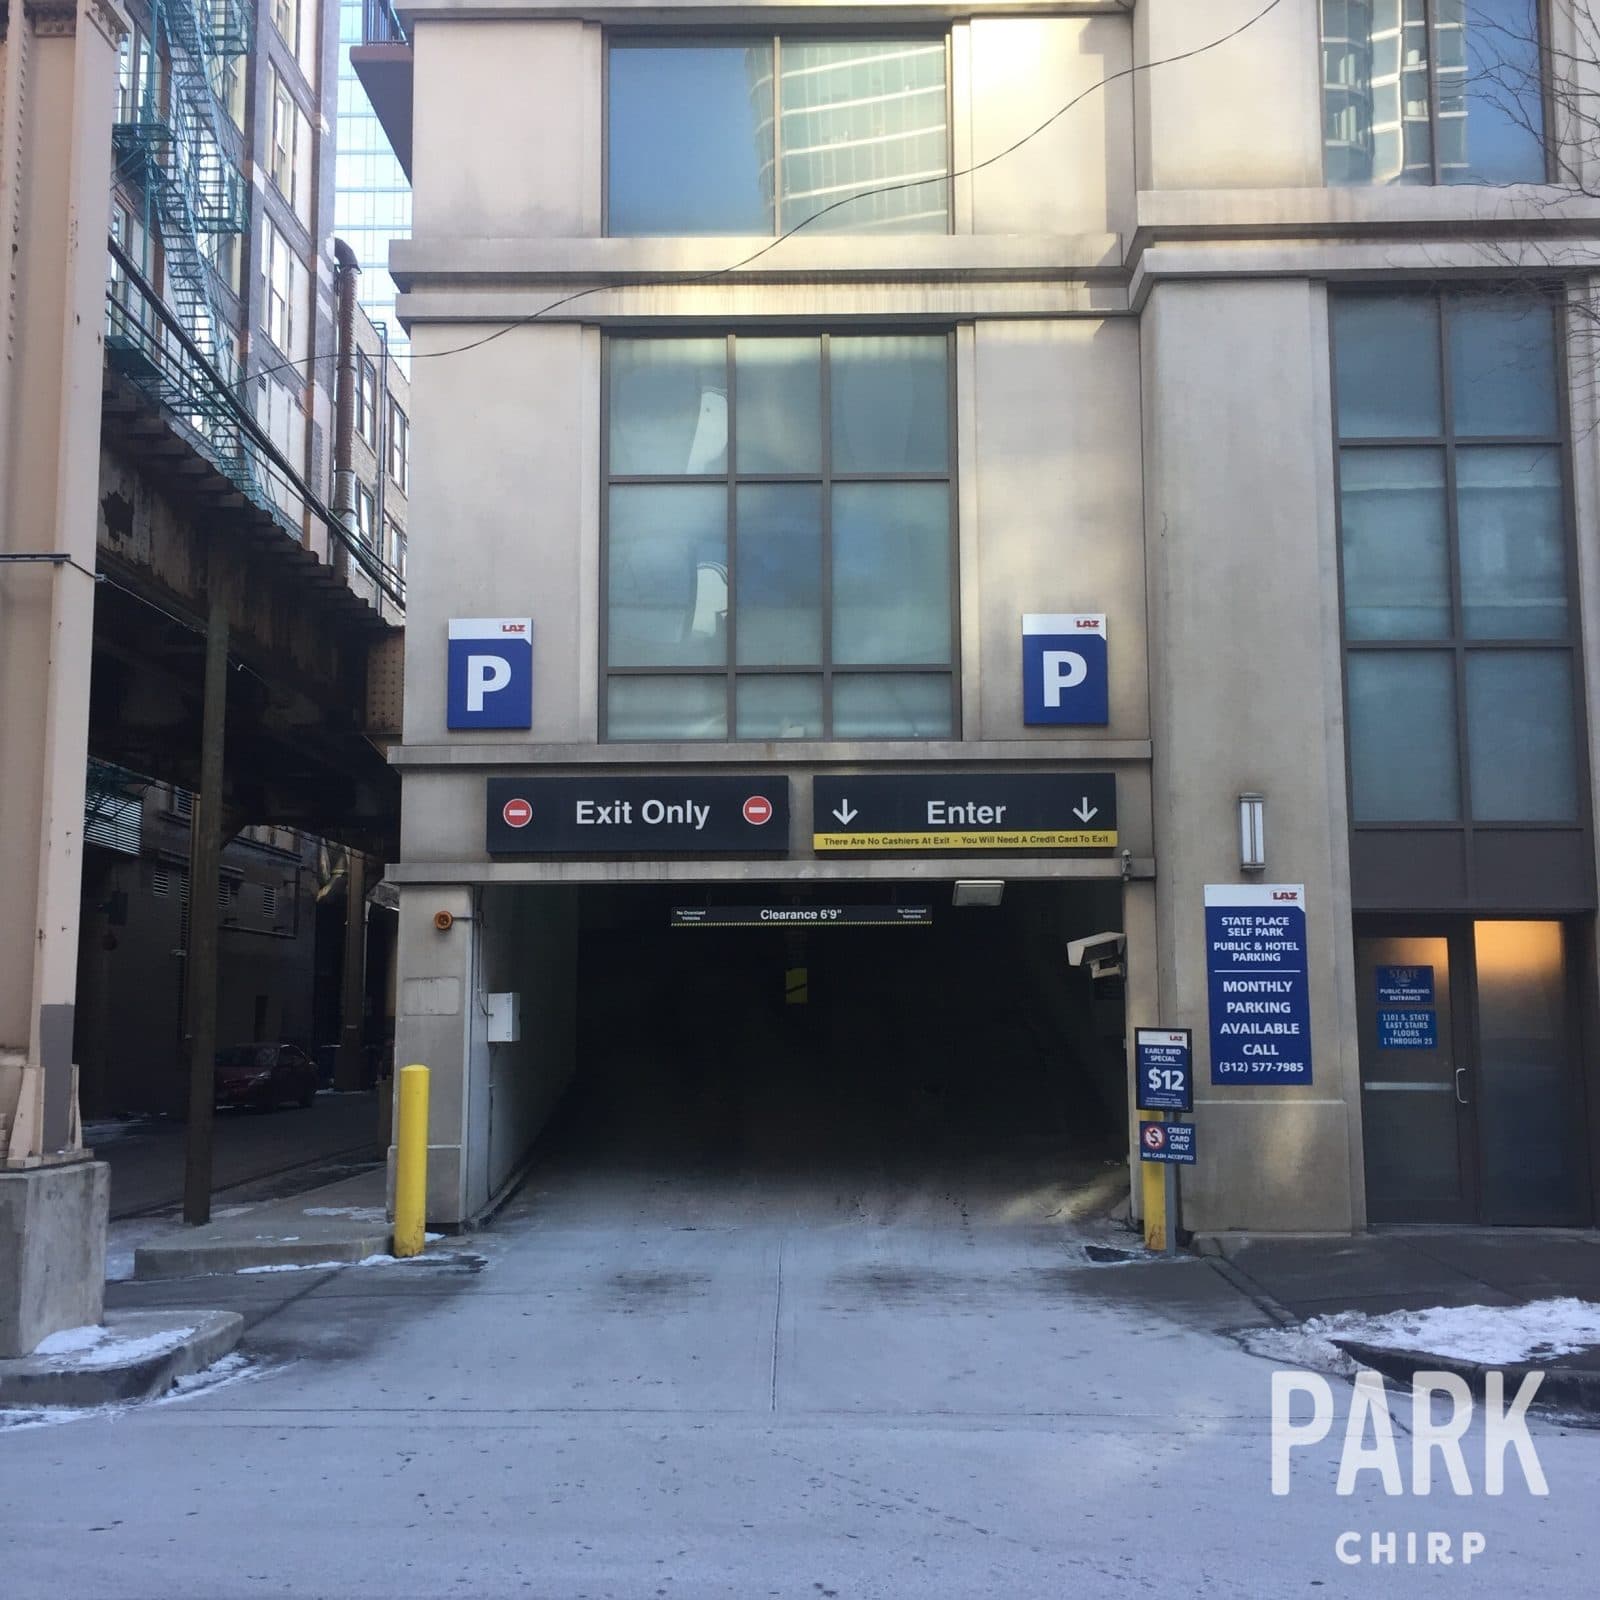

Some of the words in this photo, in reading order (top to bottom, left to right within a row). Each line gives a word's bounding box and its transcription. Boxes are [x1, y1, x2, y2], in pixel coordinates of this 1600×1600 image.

[502, 624, 526, 632] LAZ
[1076, 620, 1100, 628] LAZ
[467, 655, 512, 711] P
[1043, 650, 1088, 707] P
[576, 800, 632, 825] Exit
[642, 799, 710, 830] Only
[927, 800, 1006, 824] Enter
[824, 837, 848, 845] There
[882, 837, 919, 845] Cashiers
[934, 836, 950, 844] Exit
[962, 836, 977, 844] You
[980, 836, 994, 844] Will
[998, 836, 1019, 844] Need
[1030, 836, 1056, 844] Credit
[1272, 892, 1298, 900] LAZ
[760, 909, 817, 920] Clearance
[820, 909, 842, 920] 6'9"
[1222, 917, 1252, 926] STATE
[1256, 917, 1290, 926] PLACE
[1228, 928, 1252, 936] SELF
[1255, 928, 1284, 936] PARK
[1214, 942, 1252, 951] PUBLIC
[1254, 942, 1262, 951] &
[1265, 942, 1299, 950] HOTEL
[1232, 953, 1281, 962] PARKING
[1223, 981, 1293, 993] MONTHLY
[1226, 1002, 1291, 1014] PARKING
[1220, 1023, 1300, 1034] AVAILABLE
[1243, 1044, 1279, 1056] CALL
[1219, 1062, 1248, 1074] (312)
[1252, 1062, 1304, 1072] 577-7985
[1148, 1066, 1184, 1092] $12
[1168, 1127, 1192, 1135] CREDIT
